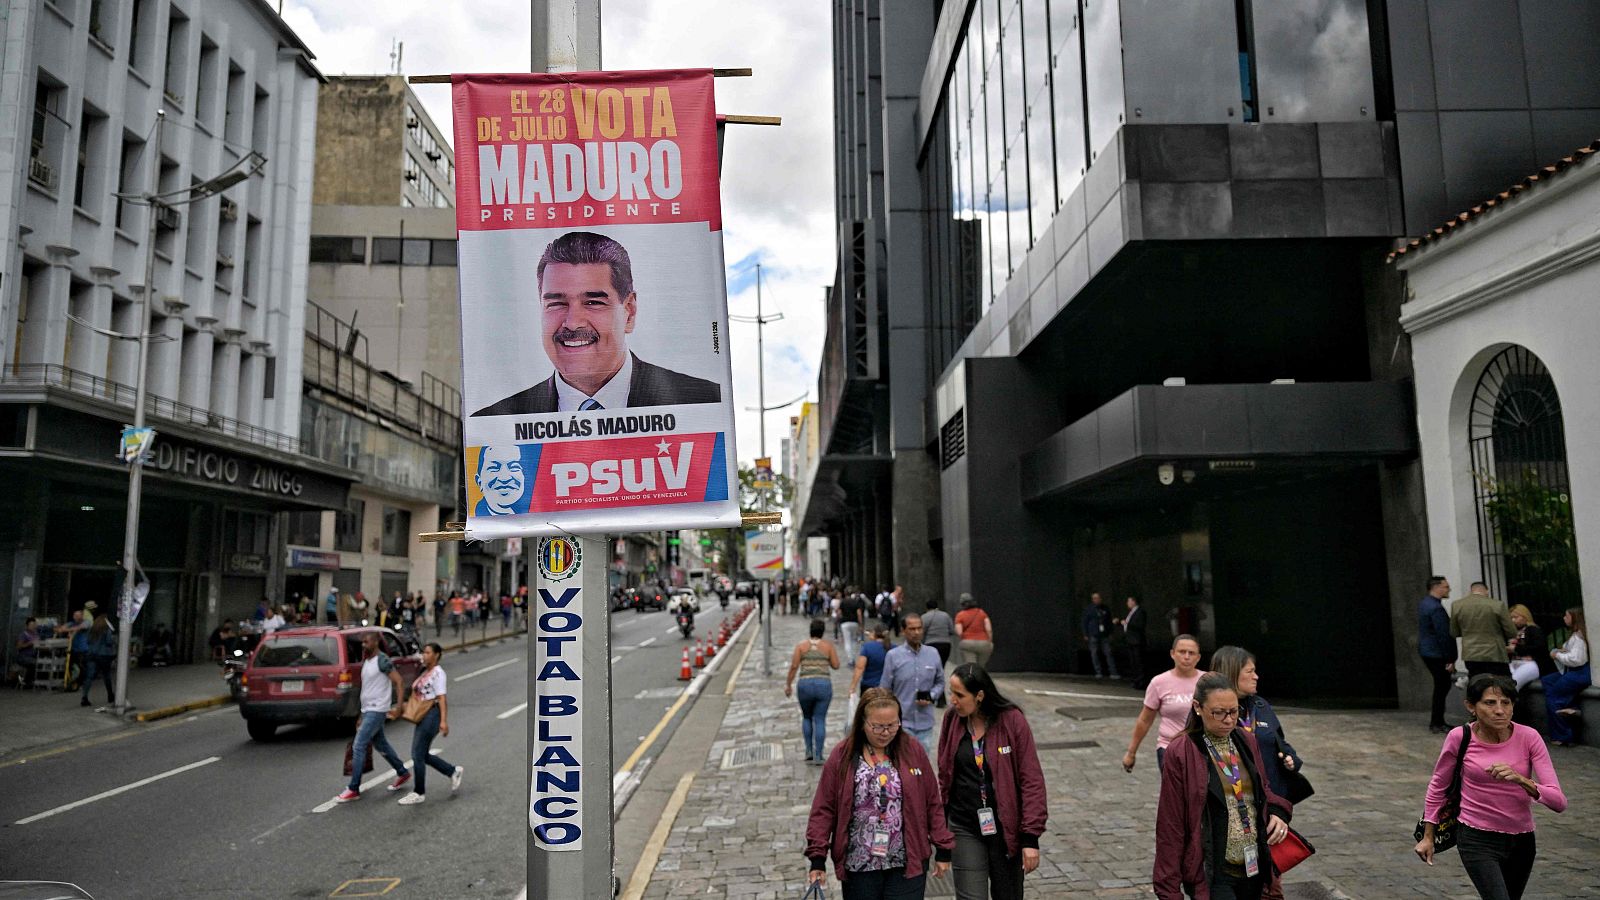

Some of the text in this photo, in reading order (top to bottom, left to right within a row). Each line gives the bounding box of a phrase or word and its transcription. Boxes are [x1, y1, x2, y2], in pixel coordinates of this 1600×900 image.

[511, 89, 565, 114] EL 28
[571, 86, 678, 140] VOTA
[477, 116, 567, 142] DE JULIO
[478, 139, 683, 206] MADURO
[481, 202, 681, 222] PRESIDENTE
[514, 413, 676, 441] NICOLÁS MADURO
[251, 463, 304, 497] ZINGG
[584, 495, 619, 503] SOCIALISTA
[652, 491, 688, 499] VENEZUELA
[536, 587, 583, 682] VOTA
[533, 694, 582, 845] BLANCO
